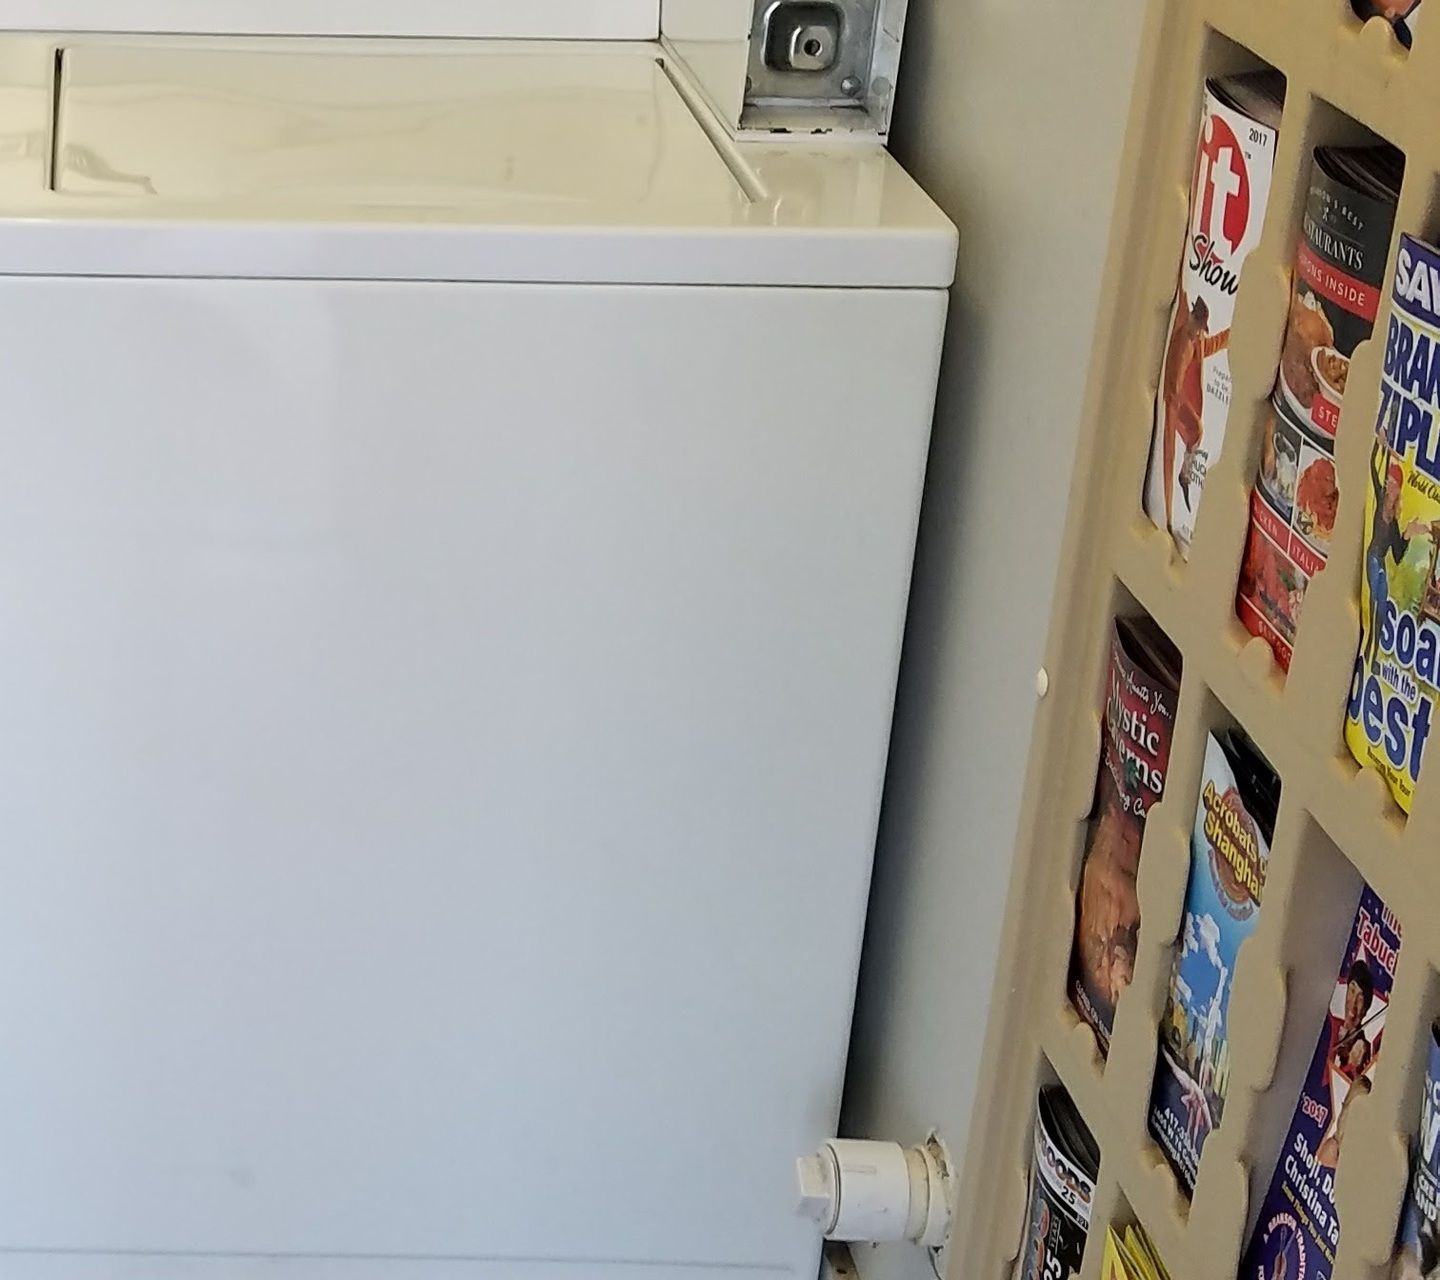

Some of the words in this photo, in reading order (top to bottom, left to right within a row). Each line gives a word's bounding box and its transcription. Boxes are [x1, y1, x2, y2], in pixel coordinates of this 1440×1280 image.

[1249, 128, 1268, 147] 2017
[1188, 234, 1239, 296] Show
[1324, 275, 1367, 308] INSIDE
[1382, 661, 1401, 688] with
[1400, 673, 1416, 702] the
[1204, 781, 1258, 862] Acrobats
[1301, 1095, 1328, 1129] 2017
[1061, 1186, 1076, 1205] 25
[1284, 1154, 1328, 1229] Christina
